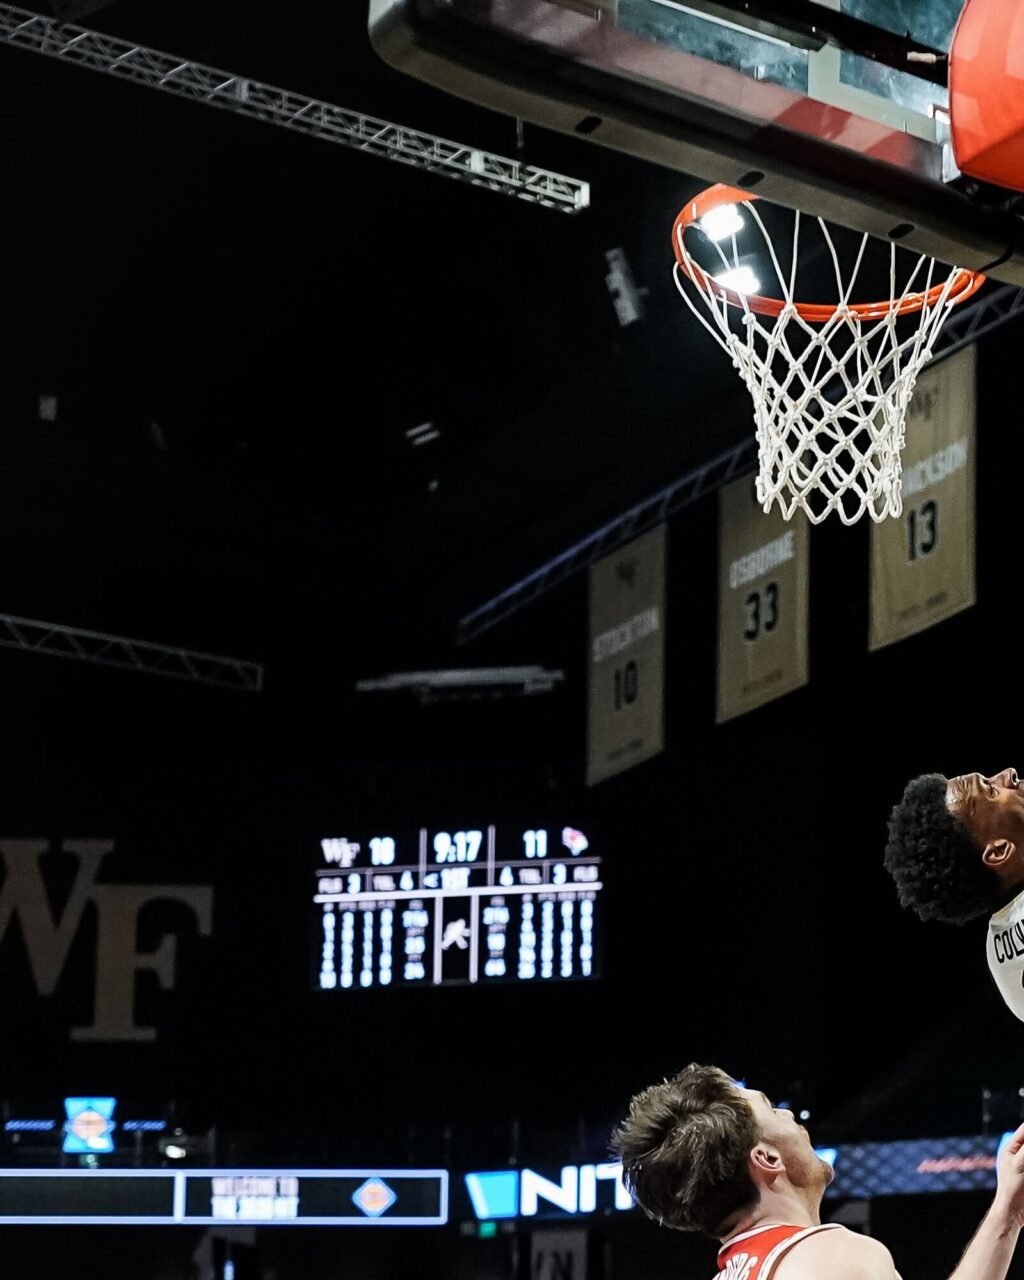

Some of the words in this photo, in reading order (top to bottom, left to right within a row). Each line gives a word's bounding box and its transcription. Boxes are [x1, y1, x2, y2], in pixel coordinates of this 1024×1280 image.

[906, 500, 939, 562] 13
[744, 581, 780, 642] 33
[614, 659, 640, 711] 10
[523, 829, 547, 858] 11
[0, 838, 214, 1042] WF
